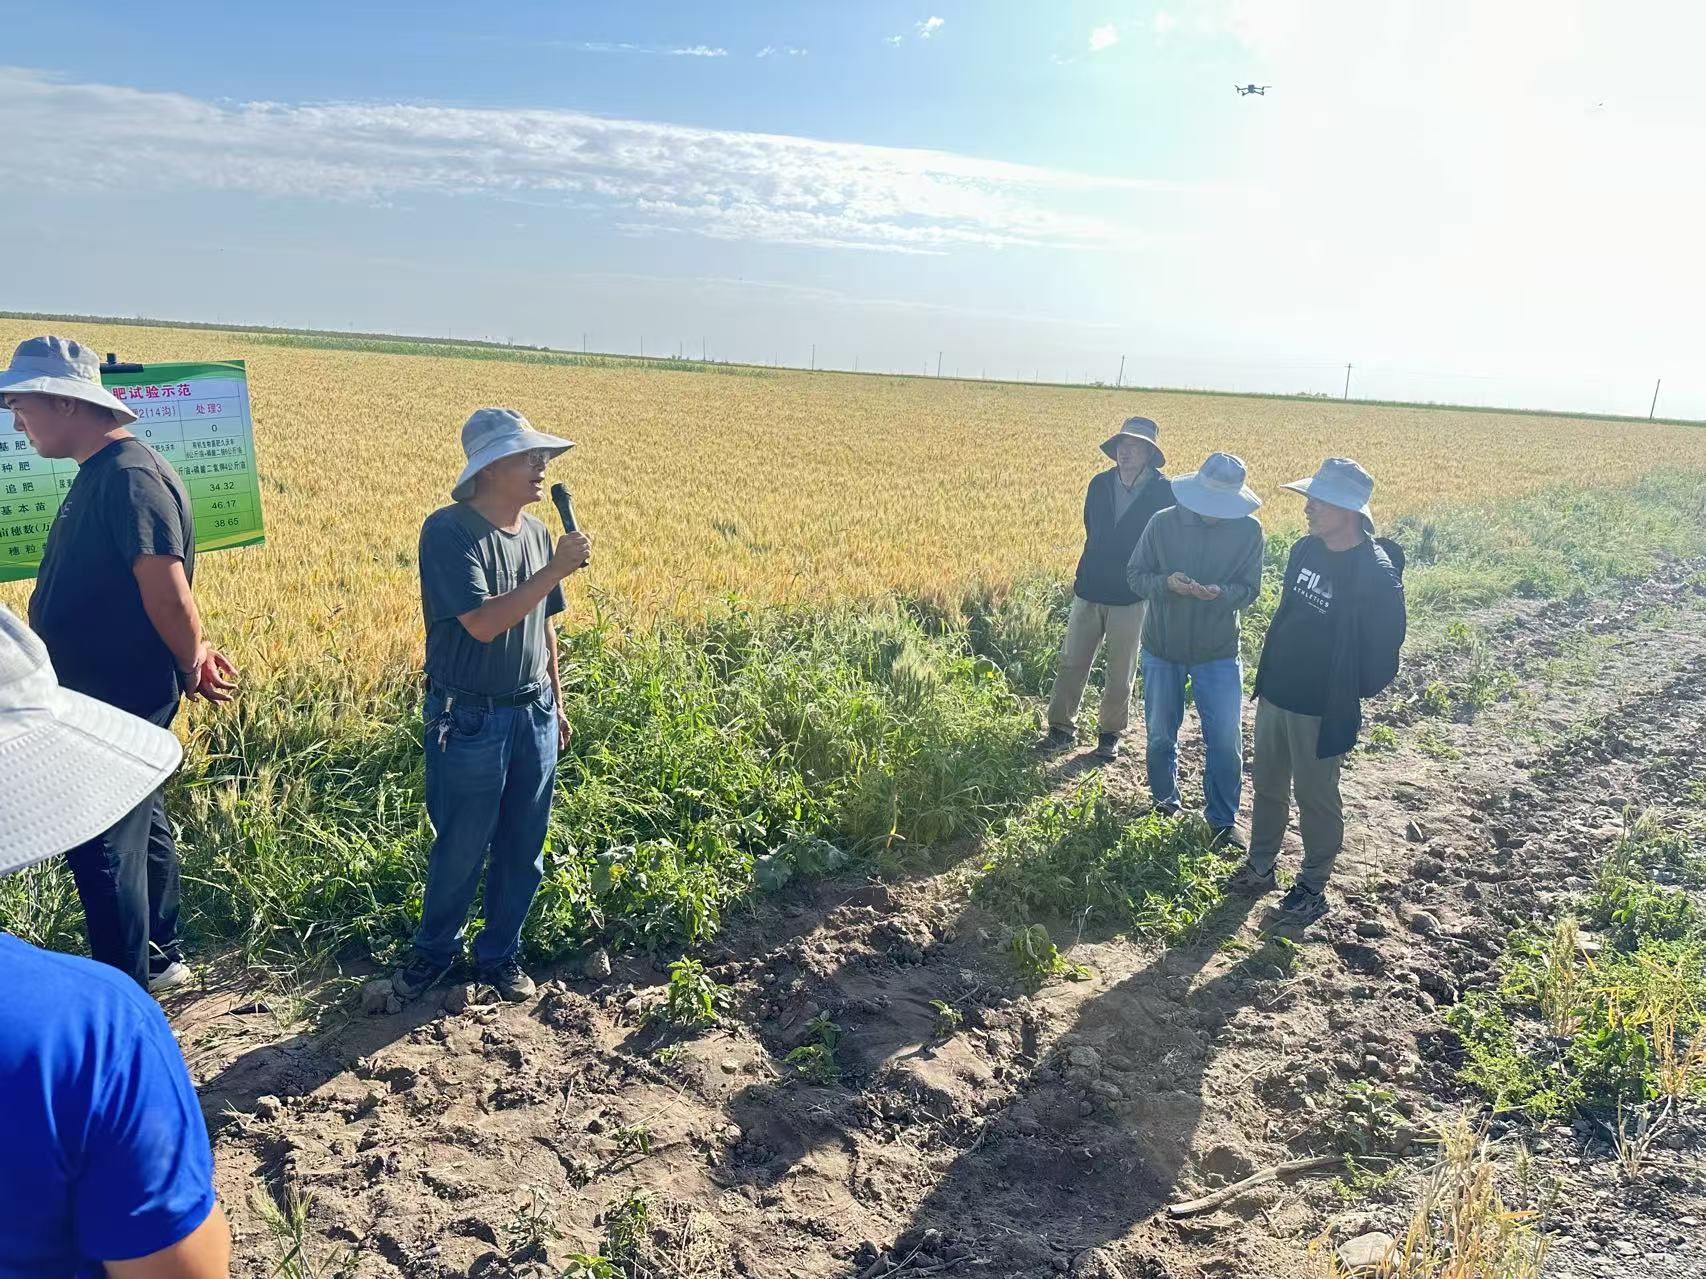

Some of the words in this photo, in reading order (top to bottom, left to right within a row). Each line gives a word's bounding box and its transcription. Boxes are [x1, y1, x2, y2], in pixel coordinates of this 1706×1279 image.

[112, 383, 192, 400] 肥试验示范
[196, 403, 222, 414] 处理3
[145, 429, 152, 438] 0
[211, 424, 218, 432] 0
[1, 461, 31, 472] 种肥
[5, 482, 34, 494] 追肥
[209, 481, 235, 492] 34.32
[1, 502, 46, 516] 基本苗
[211, 499, 236, 510] 46.17
[214, 518, 239, 528] 38.65
[1297, 568, 1333, 599] FILA
[1293, 586, 1330, 608] ATHLETICS
